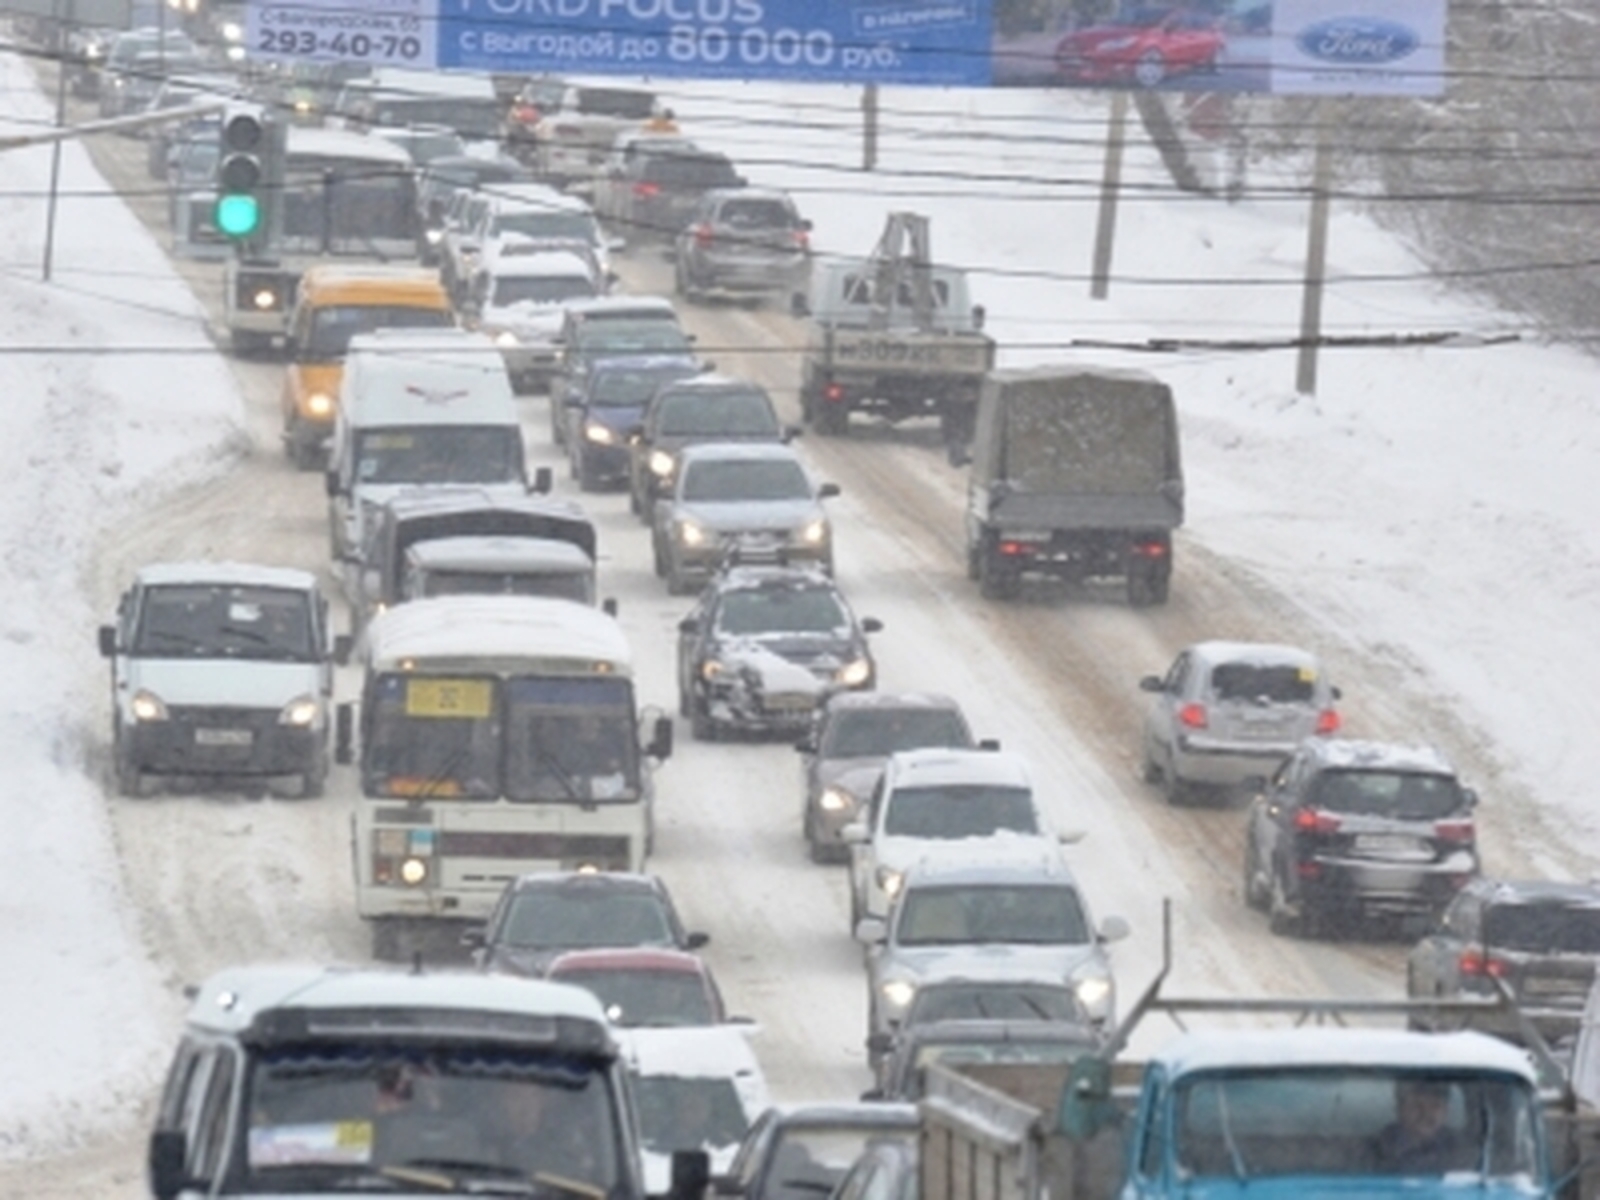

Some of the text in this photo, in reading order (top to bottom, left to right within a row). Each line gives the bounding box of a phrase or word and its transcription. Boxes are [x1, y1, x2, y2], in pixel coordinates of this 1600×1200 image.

[258, 28, 421, 60] 293-40-70
[482, 31, 615, 61] выгодой
[619, 38, 660, 61] до
[667, 24, 729, 62] 80
[739, 27, 834, 66] 000
[1318, 25, 1394, 55] Ford
